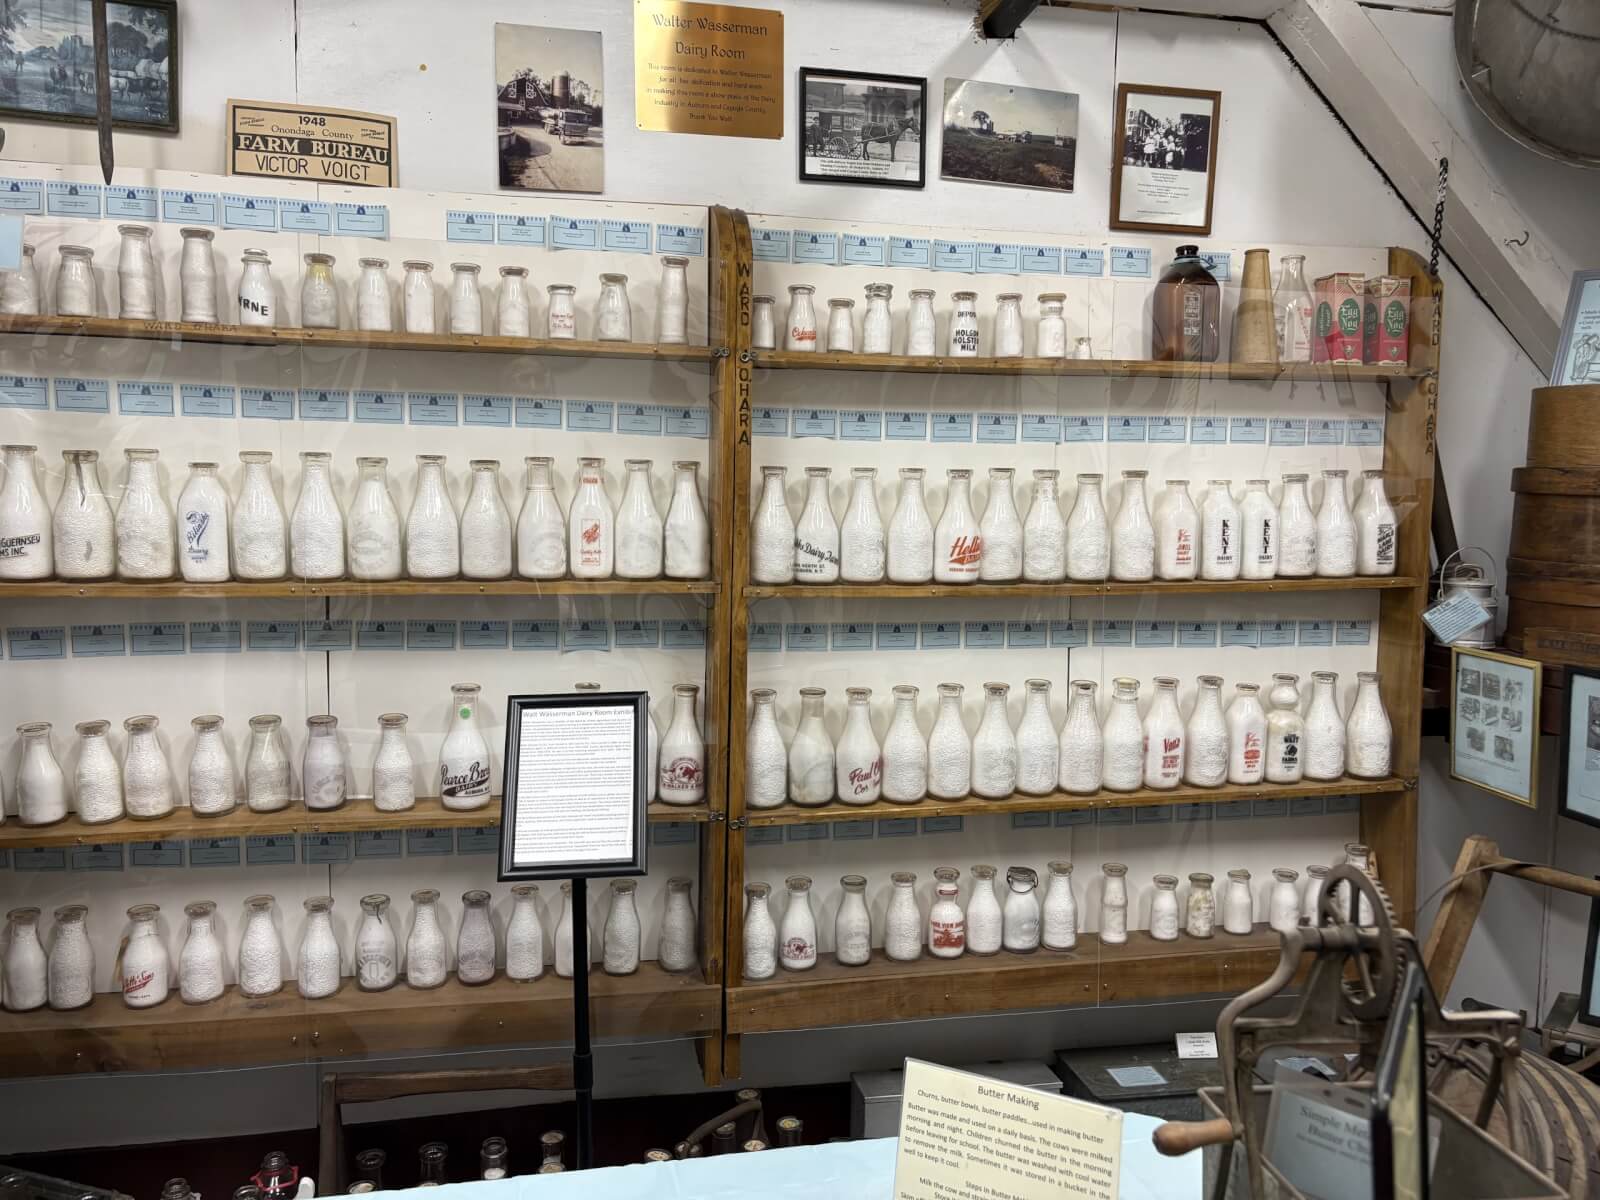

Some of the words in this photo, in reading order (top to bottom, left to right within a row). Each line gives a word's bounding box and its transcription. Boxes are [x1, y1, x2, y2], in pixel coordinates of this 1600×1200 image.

[652, 14, 692, 30] Walter
[696, 18, 768, 36] Wasserman
[675, 42, 708, 59] Dairy
[711, 44, 744, 60] Room
[298, 116, 326, 126] 1948
[270, 125, 315, 136] Onondaga
[322, 129, 354, 140] County
[238, 134, 299, 154] FARM
[311, 140, 388, 164] BUREAU
[256, 154, 308, 174] VICTOR
[321, 160, 370, 182] VOIGT
[737, 263, 750, 326] WARD
[1341, 304, 1358, 319] Egg
[1388, 306, 1404, 320] Egg
[1342, 318, 1358, 330] Nog
[1388, 319, 1404, 332] Nog
[961, 344, 976, 352] MILK
[1222, 520, 1230, 554] KENT
[1264, 519, 1272, 554] KENT
[11, 546, 24, 556] INC
[440, 764, 468, 786] Pearce
[978, 1086, 1005, 1100] Butter
[1006, 1093, 1040, 1110] Making
[918, 1090, 940, 1102] Churns,
[941, 1096, 960, 1106] butter
[961, 1100, 980, 1112] bowls,
[982, 1106, 1002, 1117] butter
[1048, 1124, 1056, 1132] in
[1057, 1126, 1081, 1140] making
[1082, 1132, 1104, 1144] butter
[908, 1102, 926, 1112] Butter
[940, 1112, 957, 1120] made
[958, 1117, 970, 1125] and
[972, 1120, 986, 1129] used
[1003, 1127, 1018, 1138] daily
[1019, 1132, 1036, 1142] basis.
[1040, 1136, 1051, 1146] The
[1052, 1142, 1070, 1151] cows
[1071, 1148, 1088, 1156] were
[1090, 1152, 1112, 1164] milked
[906, 1114, 931, 1126] morning
[934, 1120, 944, 1129] and
[966, 1130, 992, 1141] Children
[994, 1138, 1020, 1150] churned
[1024, 1146, 1034, 1154] the
[1036, 1149, 1057, 1160] butter
[1070, 1158, 1080, 1167] the
[1084, 1162, 1112, 1177] morning
[906, 1124, 925, 1136] Before
[926, 1130, 948, 1142] leaving
[948, 1136, 958, 1144] for
[960, 1139, 980, 1151] school.
[982, 1146, 994, 1154] The
[996, 1150, 1016, 1160] butter
[1018, 1156, 1030, 1164] was
[1032, 1161, 1056, 1172] washed
[1058, 1168, 1073, 1178] with
[1075, 1172, 1089, 1182] cool
[1091, 1178, 1112, 1188] water
[913, 1139, 936, 1150] remove
[938, 1144, 948, 1153] the
[966, 1152, 1000, 1168] Sometimes
[1010, 1167, 1022, 1176] was
[1025, 1170, 1046, 1182] stored
[1048, 1176, 1054, 1184] in
[1064, 1182, 1086, 1194] bucket
[1090, 1188, 1096, 1196] in
[1098, 1192, 1110, 1200] the
[924, 1153, 939, 1164] keep
[920, 1177, 932, 1186] Milk
[934, 1181, 944, 1190] the
[944, 1186, 957, 1194] cow
[958, 1190, 970, 1198] and
[966, 1180, 982, 1192] Steps
[984, 1186, 990, 1194] in
